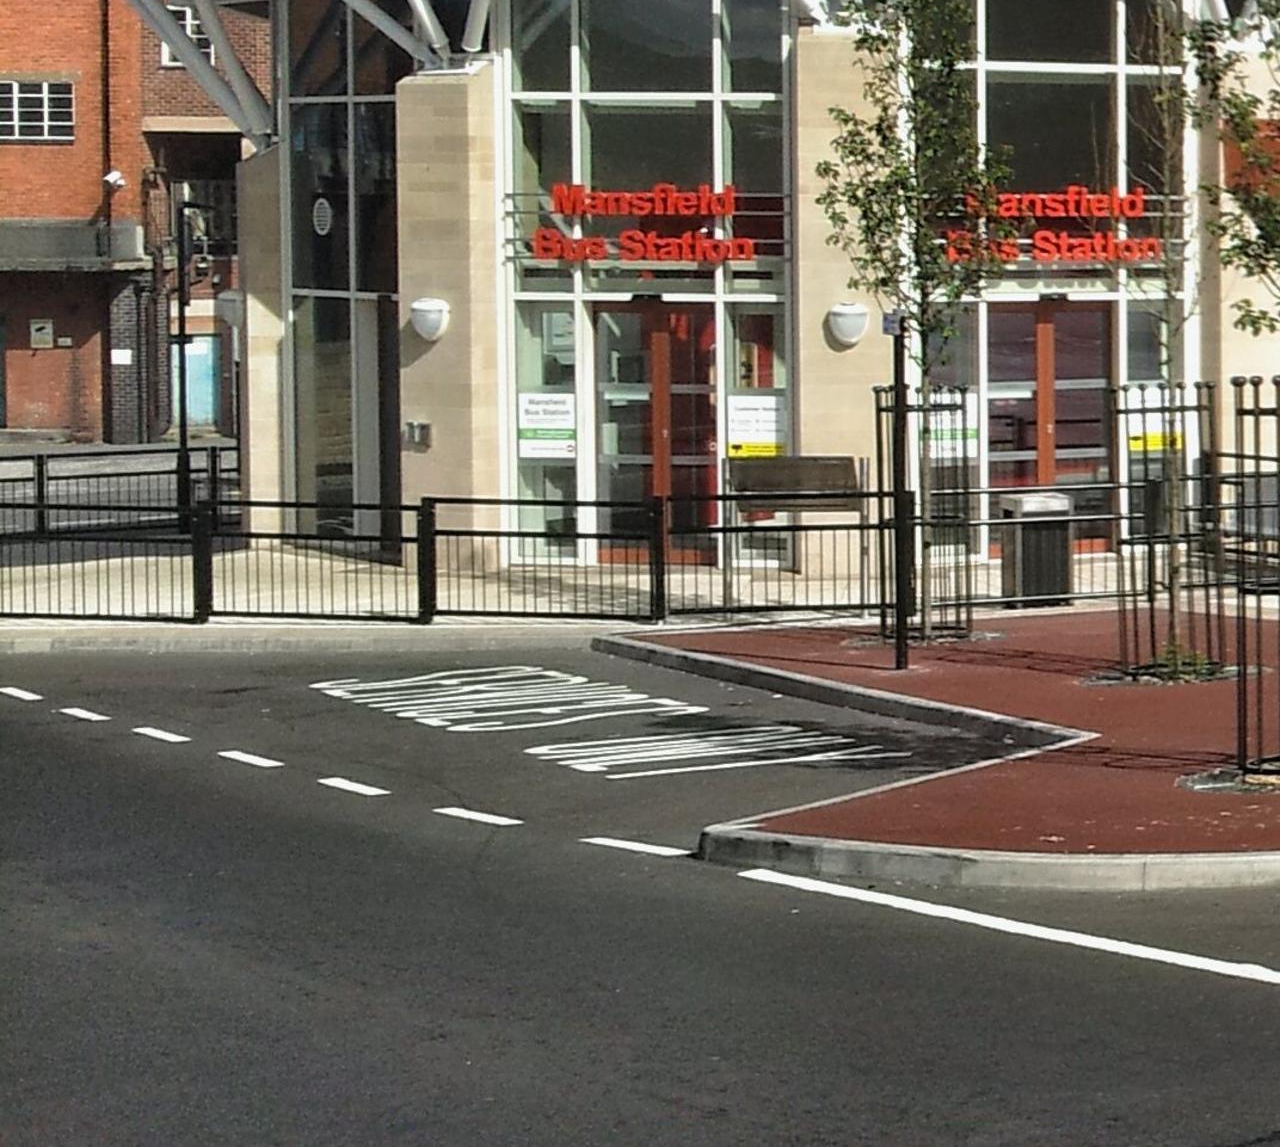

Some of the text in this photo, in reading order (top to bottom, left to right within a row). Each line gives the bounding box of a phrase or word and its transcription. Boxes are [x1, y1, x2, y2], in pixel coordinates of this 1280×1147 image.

[552, 183, 736, 216] Mansfield
[532, 227, 757, 262] Bus Station
[1033, 229, 1162, 262] Station
[309, 665, 711, 732] SERVICES
[523, 725, 912, 779] ONLY
